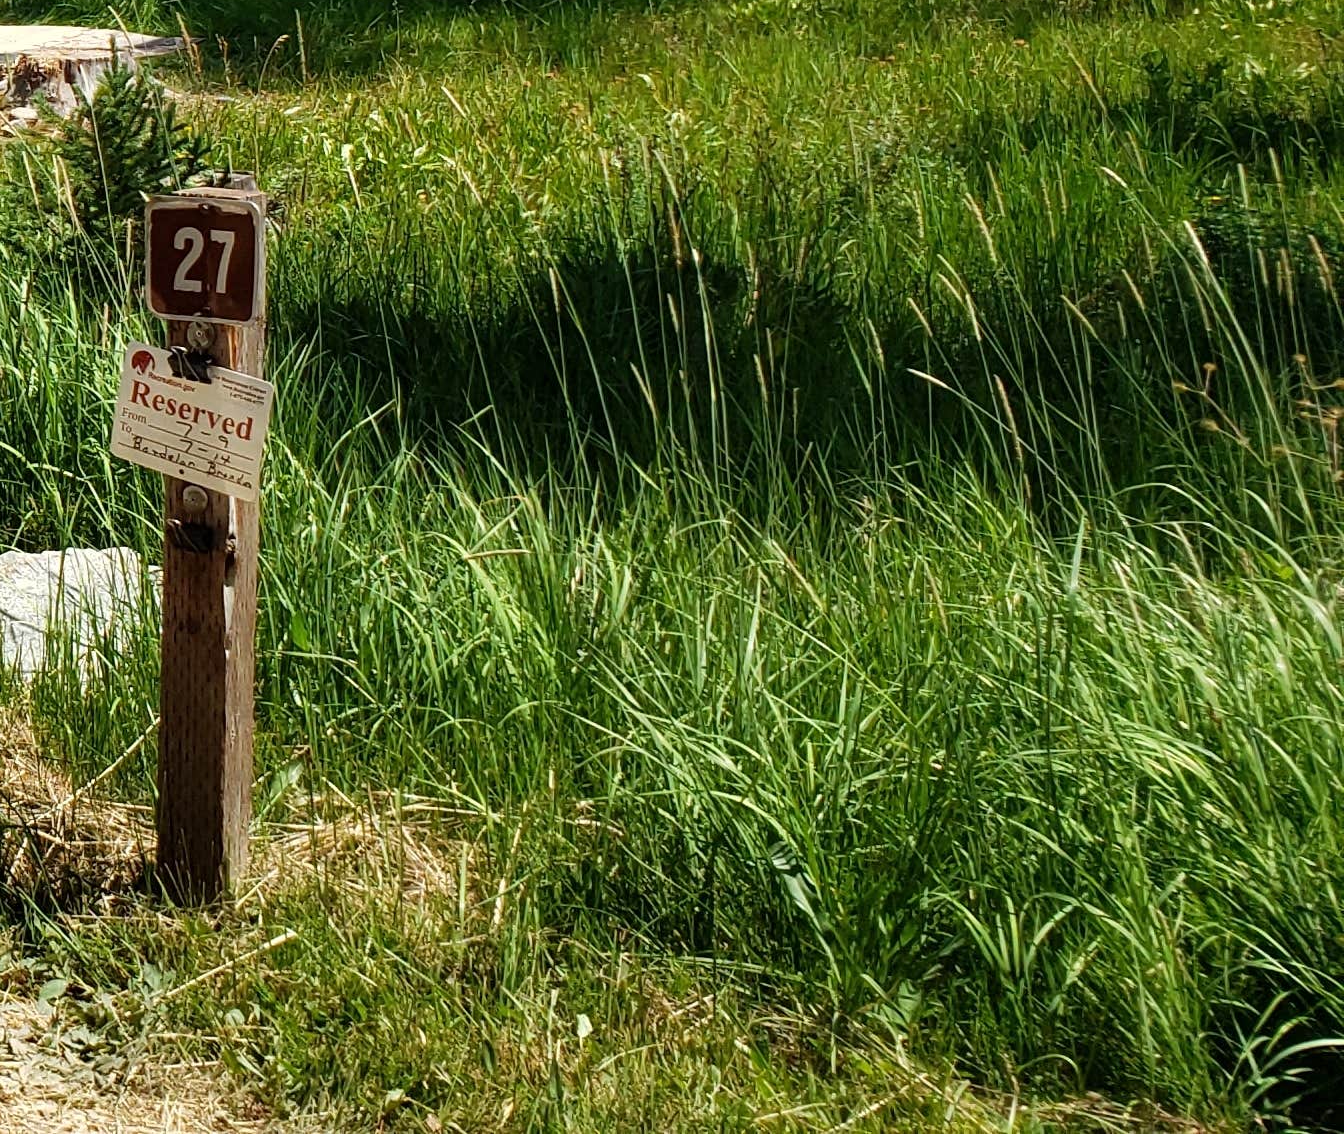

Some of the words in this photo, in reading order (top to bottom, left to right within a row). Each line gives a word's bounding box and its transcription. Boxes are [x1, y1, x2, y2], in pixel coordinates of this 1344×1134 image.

[172, 226, 236, 294] 27
[120, 420, 133, 434] To
[121, 406, 147, 425] From
[129, 379, 253, 442] Reserved
